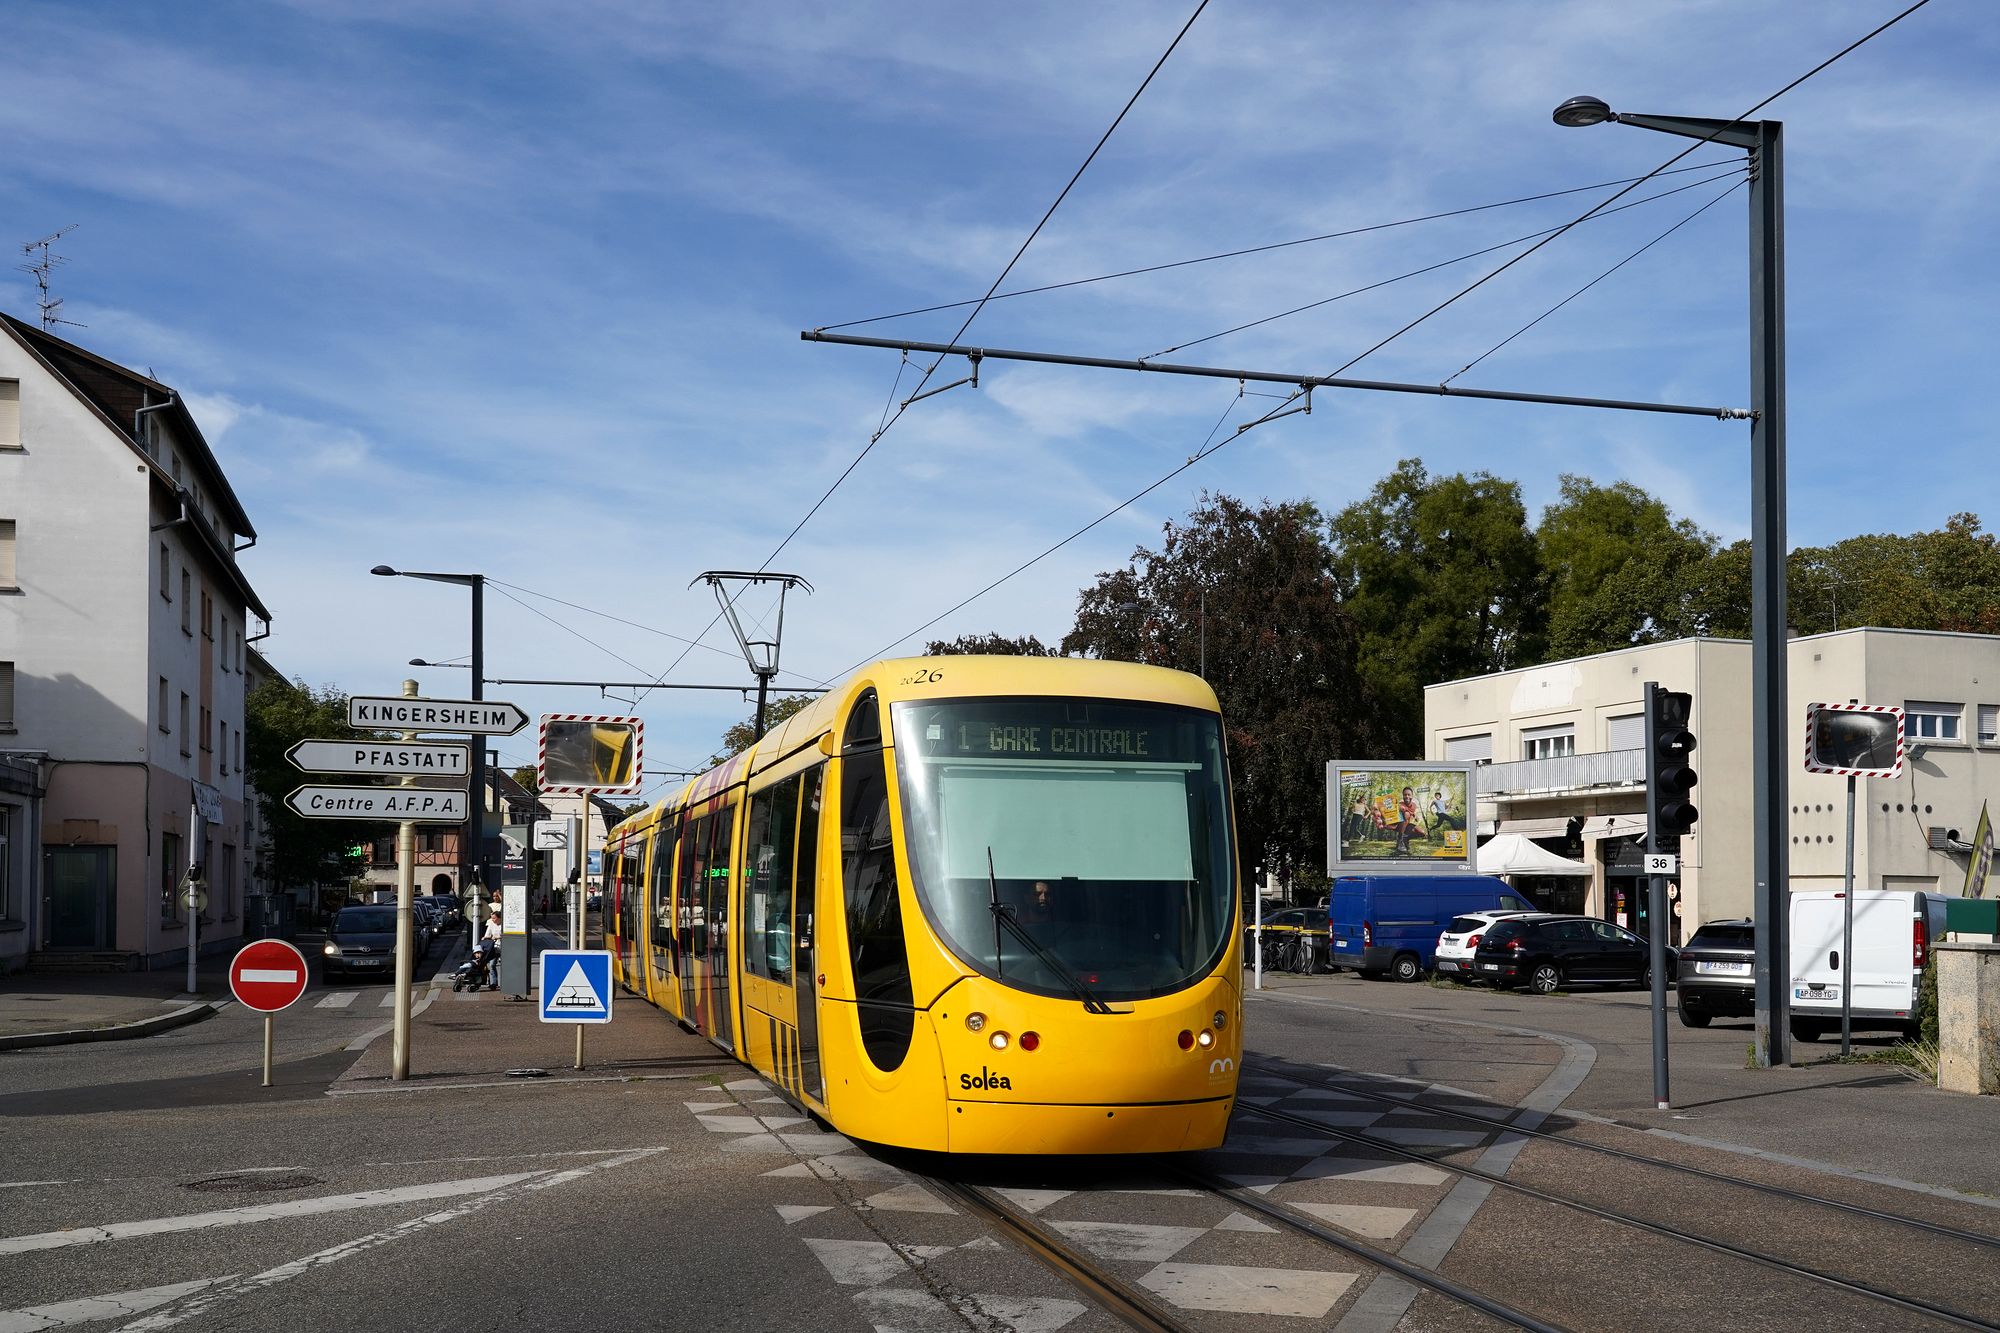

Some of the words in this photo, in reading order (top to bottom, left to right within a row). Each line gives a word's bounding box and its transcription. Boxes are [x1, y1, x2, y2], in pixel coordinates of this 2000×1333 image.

[900, 667, 944, 686] 2026
[358, 705, 507, 726] KINGERSHEIM
[989, 727, 1041, 752] GARE
[1051, 727, 1149, 755] CENTRALE
[355, 750, 460, 768] PFASTATT
[311, 795, 374, 811] Centre
[385, 797, 459, 813] A.F.P.A.
[1652, 858, 1668, 869] 36
[960, 1066, 1012, 1090] Soléa
